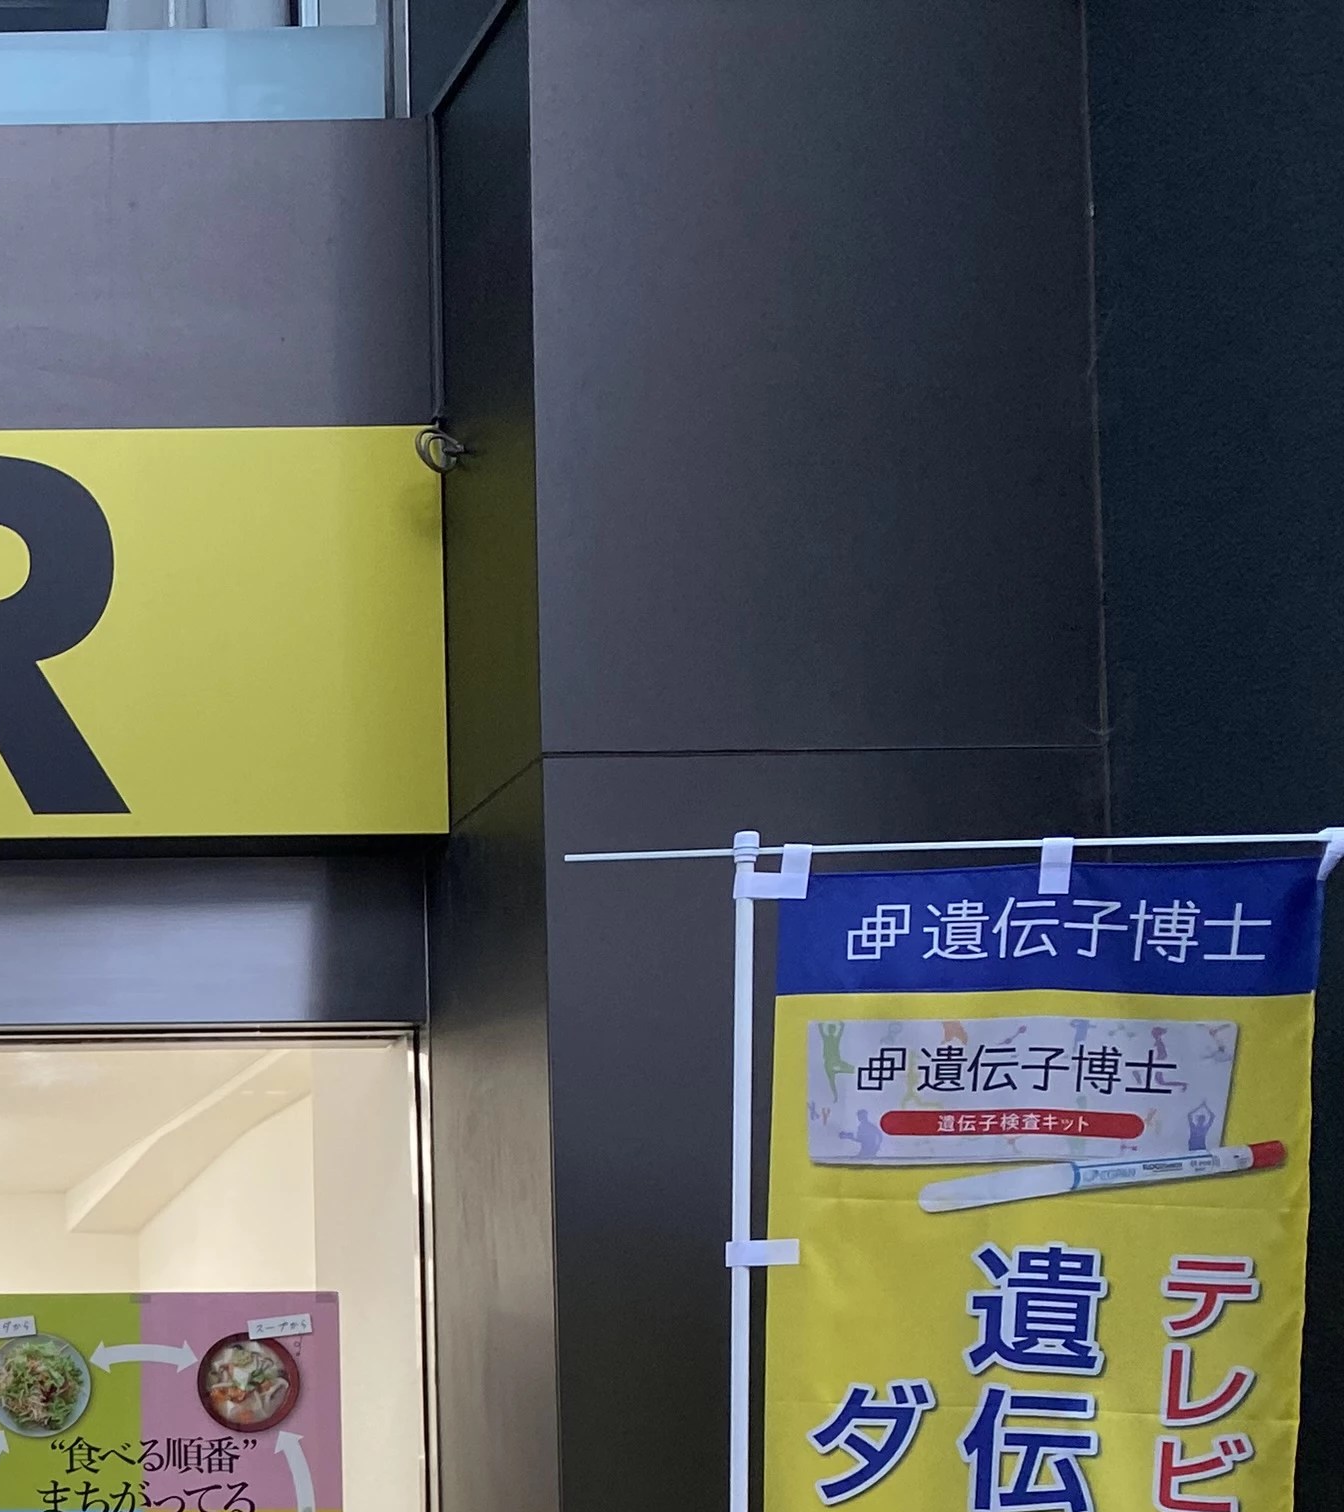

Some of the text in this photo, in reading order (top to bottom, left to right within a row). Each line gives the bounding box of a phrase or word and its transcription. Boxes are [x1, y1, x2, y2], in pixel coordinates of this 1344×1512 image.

[922, 896, 1272, 964] 遺伝子博士
[916, 1045, 1178, 1095] 遺伝子博士
[936, 1113, 1091, 1134] 遺伝子検査キット
